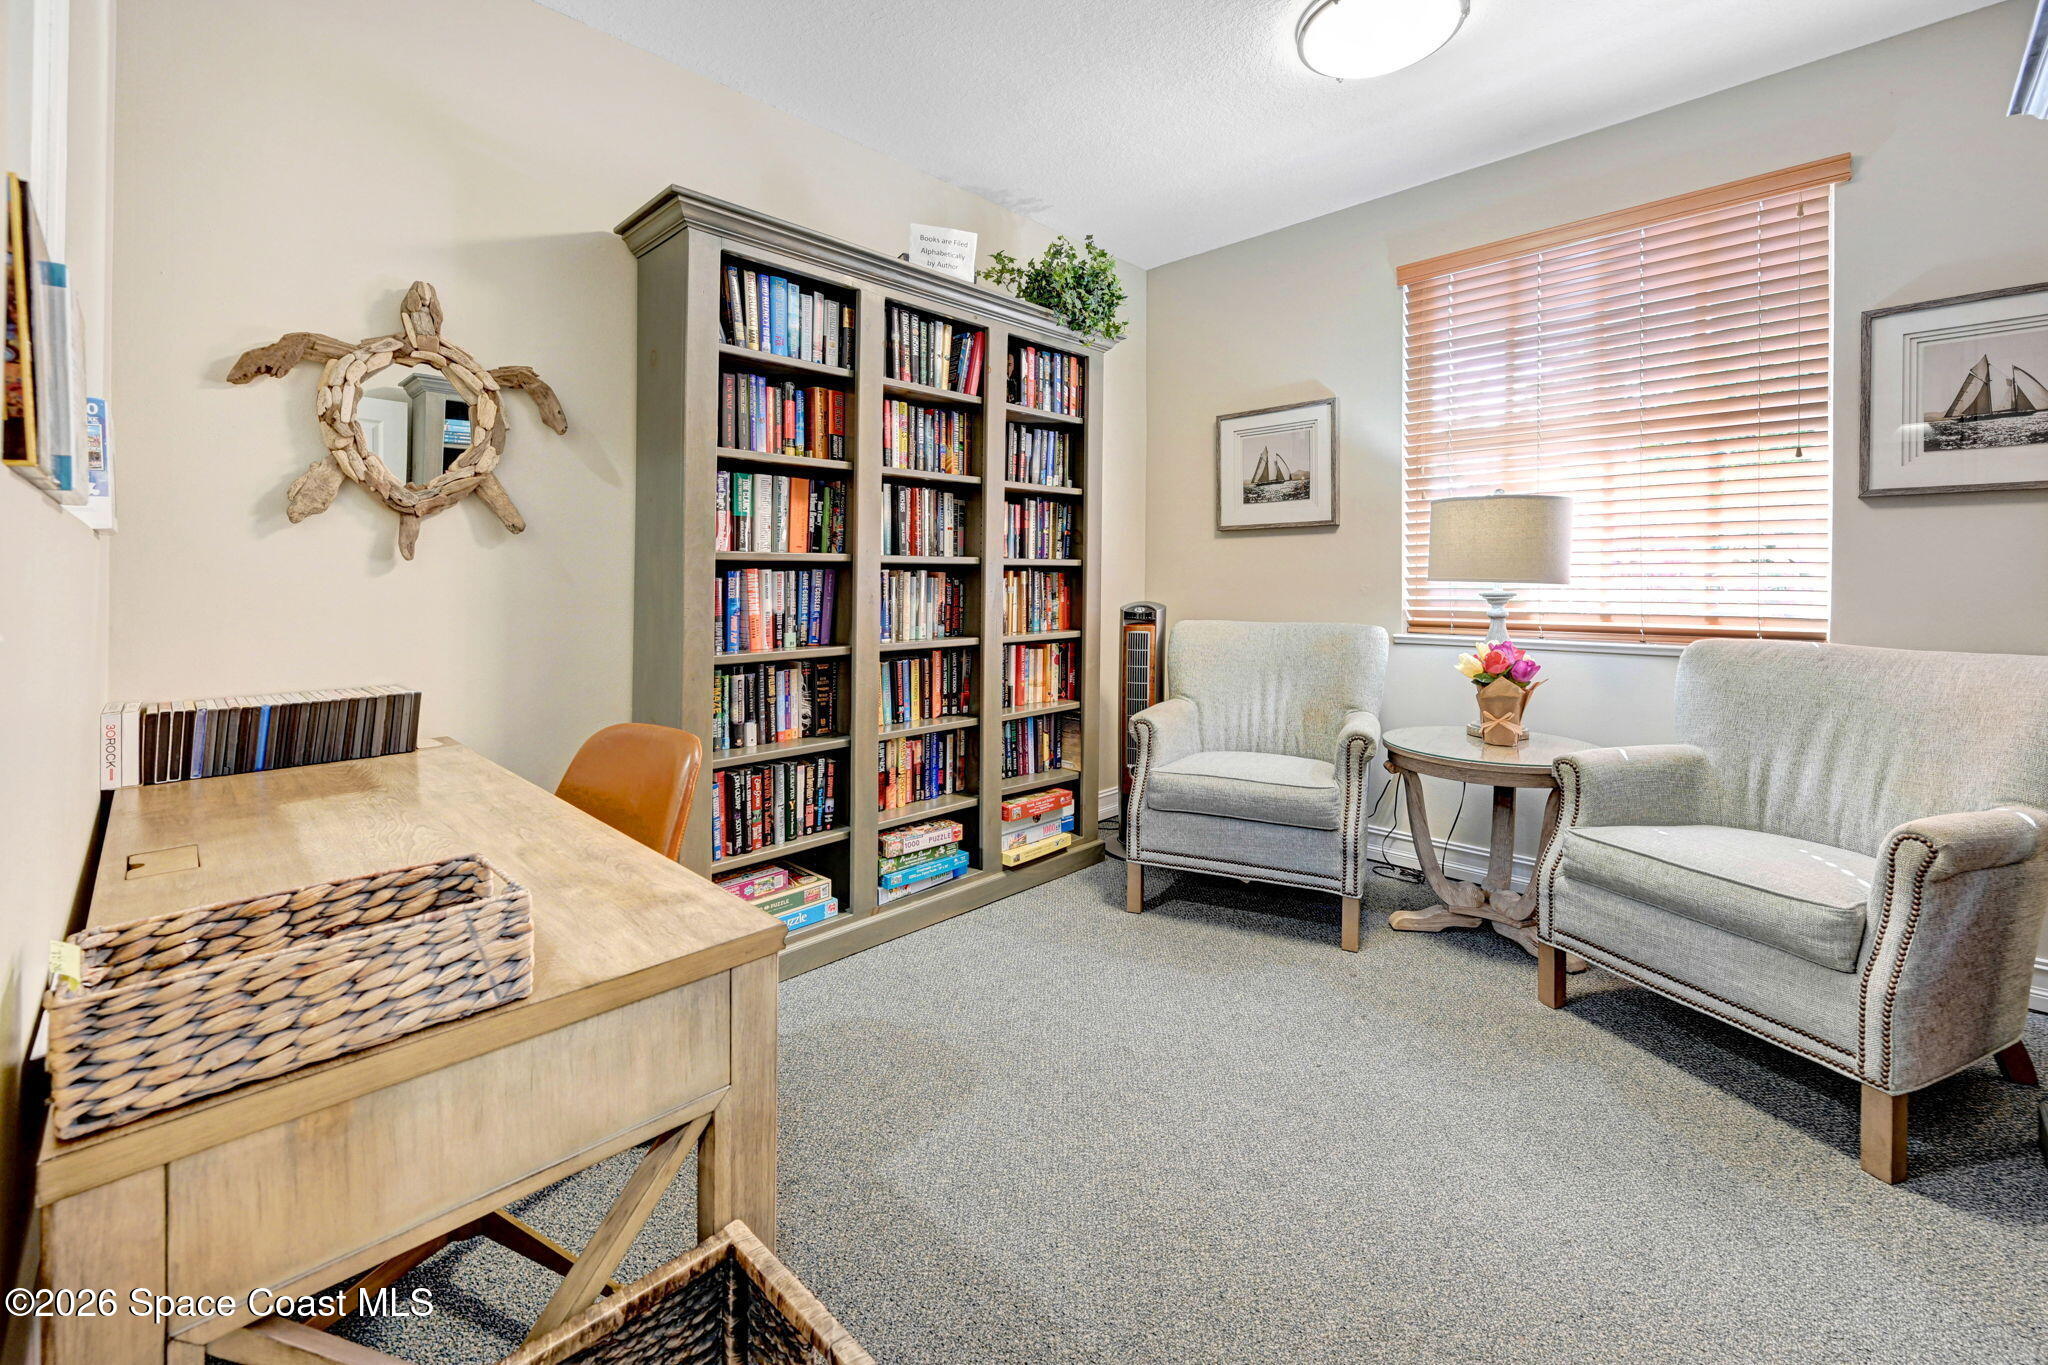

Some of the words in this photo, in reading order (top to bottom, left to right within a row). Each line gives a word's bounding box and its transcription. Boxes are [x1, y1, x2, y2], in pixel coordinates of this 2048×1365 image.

[920, 234, 940, 243] Books
[954, 239, 968, 248] Filed
[920, 248, 966, 261] Alphabetically
[927, 260, 936, 268] by
[936, 262, 959, 270] Author
[726, 377, 734, 392] IRON
[815, 572, 824, 587] CLIVE
[728, 577, 737, 599] COULTER
[814, 588, 822, 612] CUSSLER
[713, 688, 722, 715] MAZE
[904, 840, 920, 849] 1000
[928, 832, 952, 844] PUZZLE
[770, 898, 790, 908] PUZZLE
